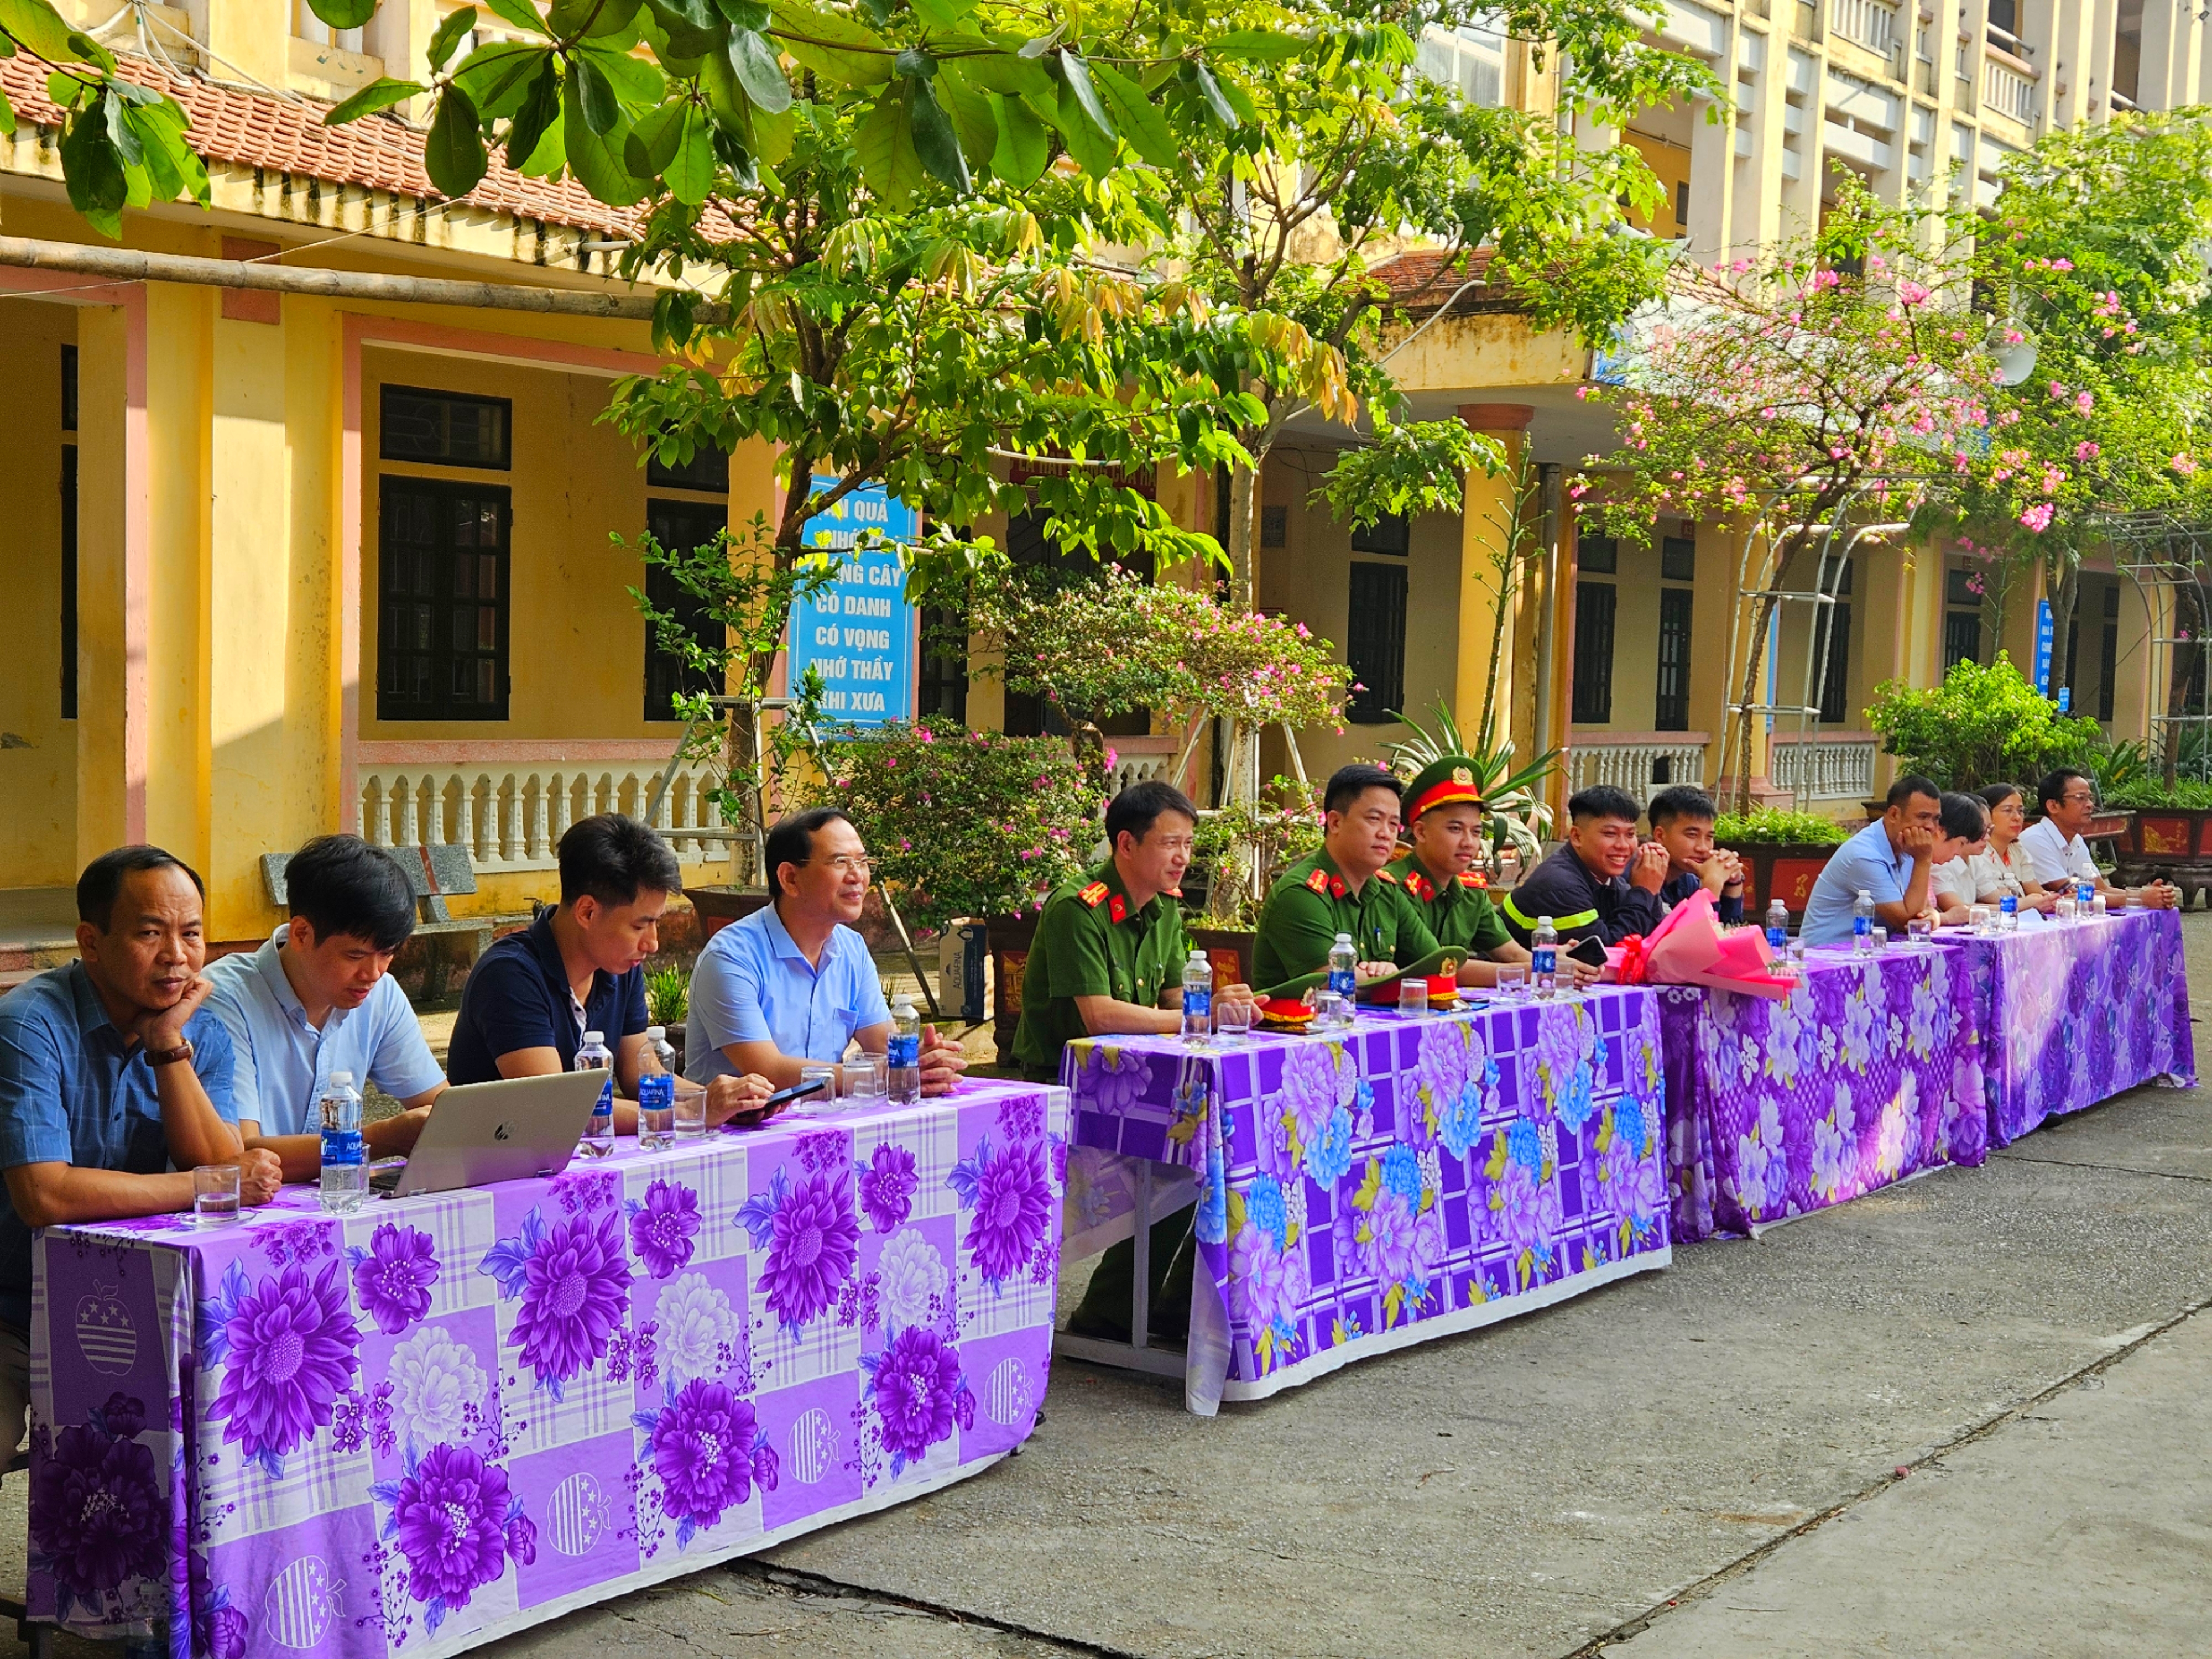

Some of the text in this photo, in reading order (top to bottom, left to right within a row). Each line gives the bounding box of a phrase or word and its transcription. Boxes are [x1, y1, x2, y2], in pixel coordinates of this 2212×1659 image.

[854, 498, 889, 522] QUẢ
[869, 564, 902, 586] CÂY
[816, 591, 891, 617] CÓ DANH
[816, 623, 890, 651] CÓ VỌNG
[810, 655, 894, 680] NHỚ THẦY
[851, 692, 885, 711] XƯA
[953, 950, 962, 990] AQUAFINA
